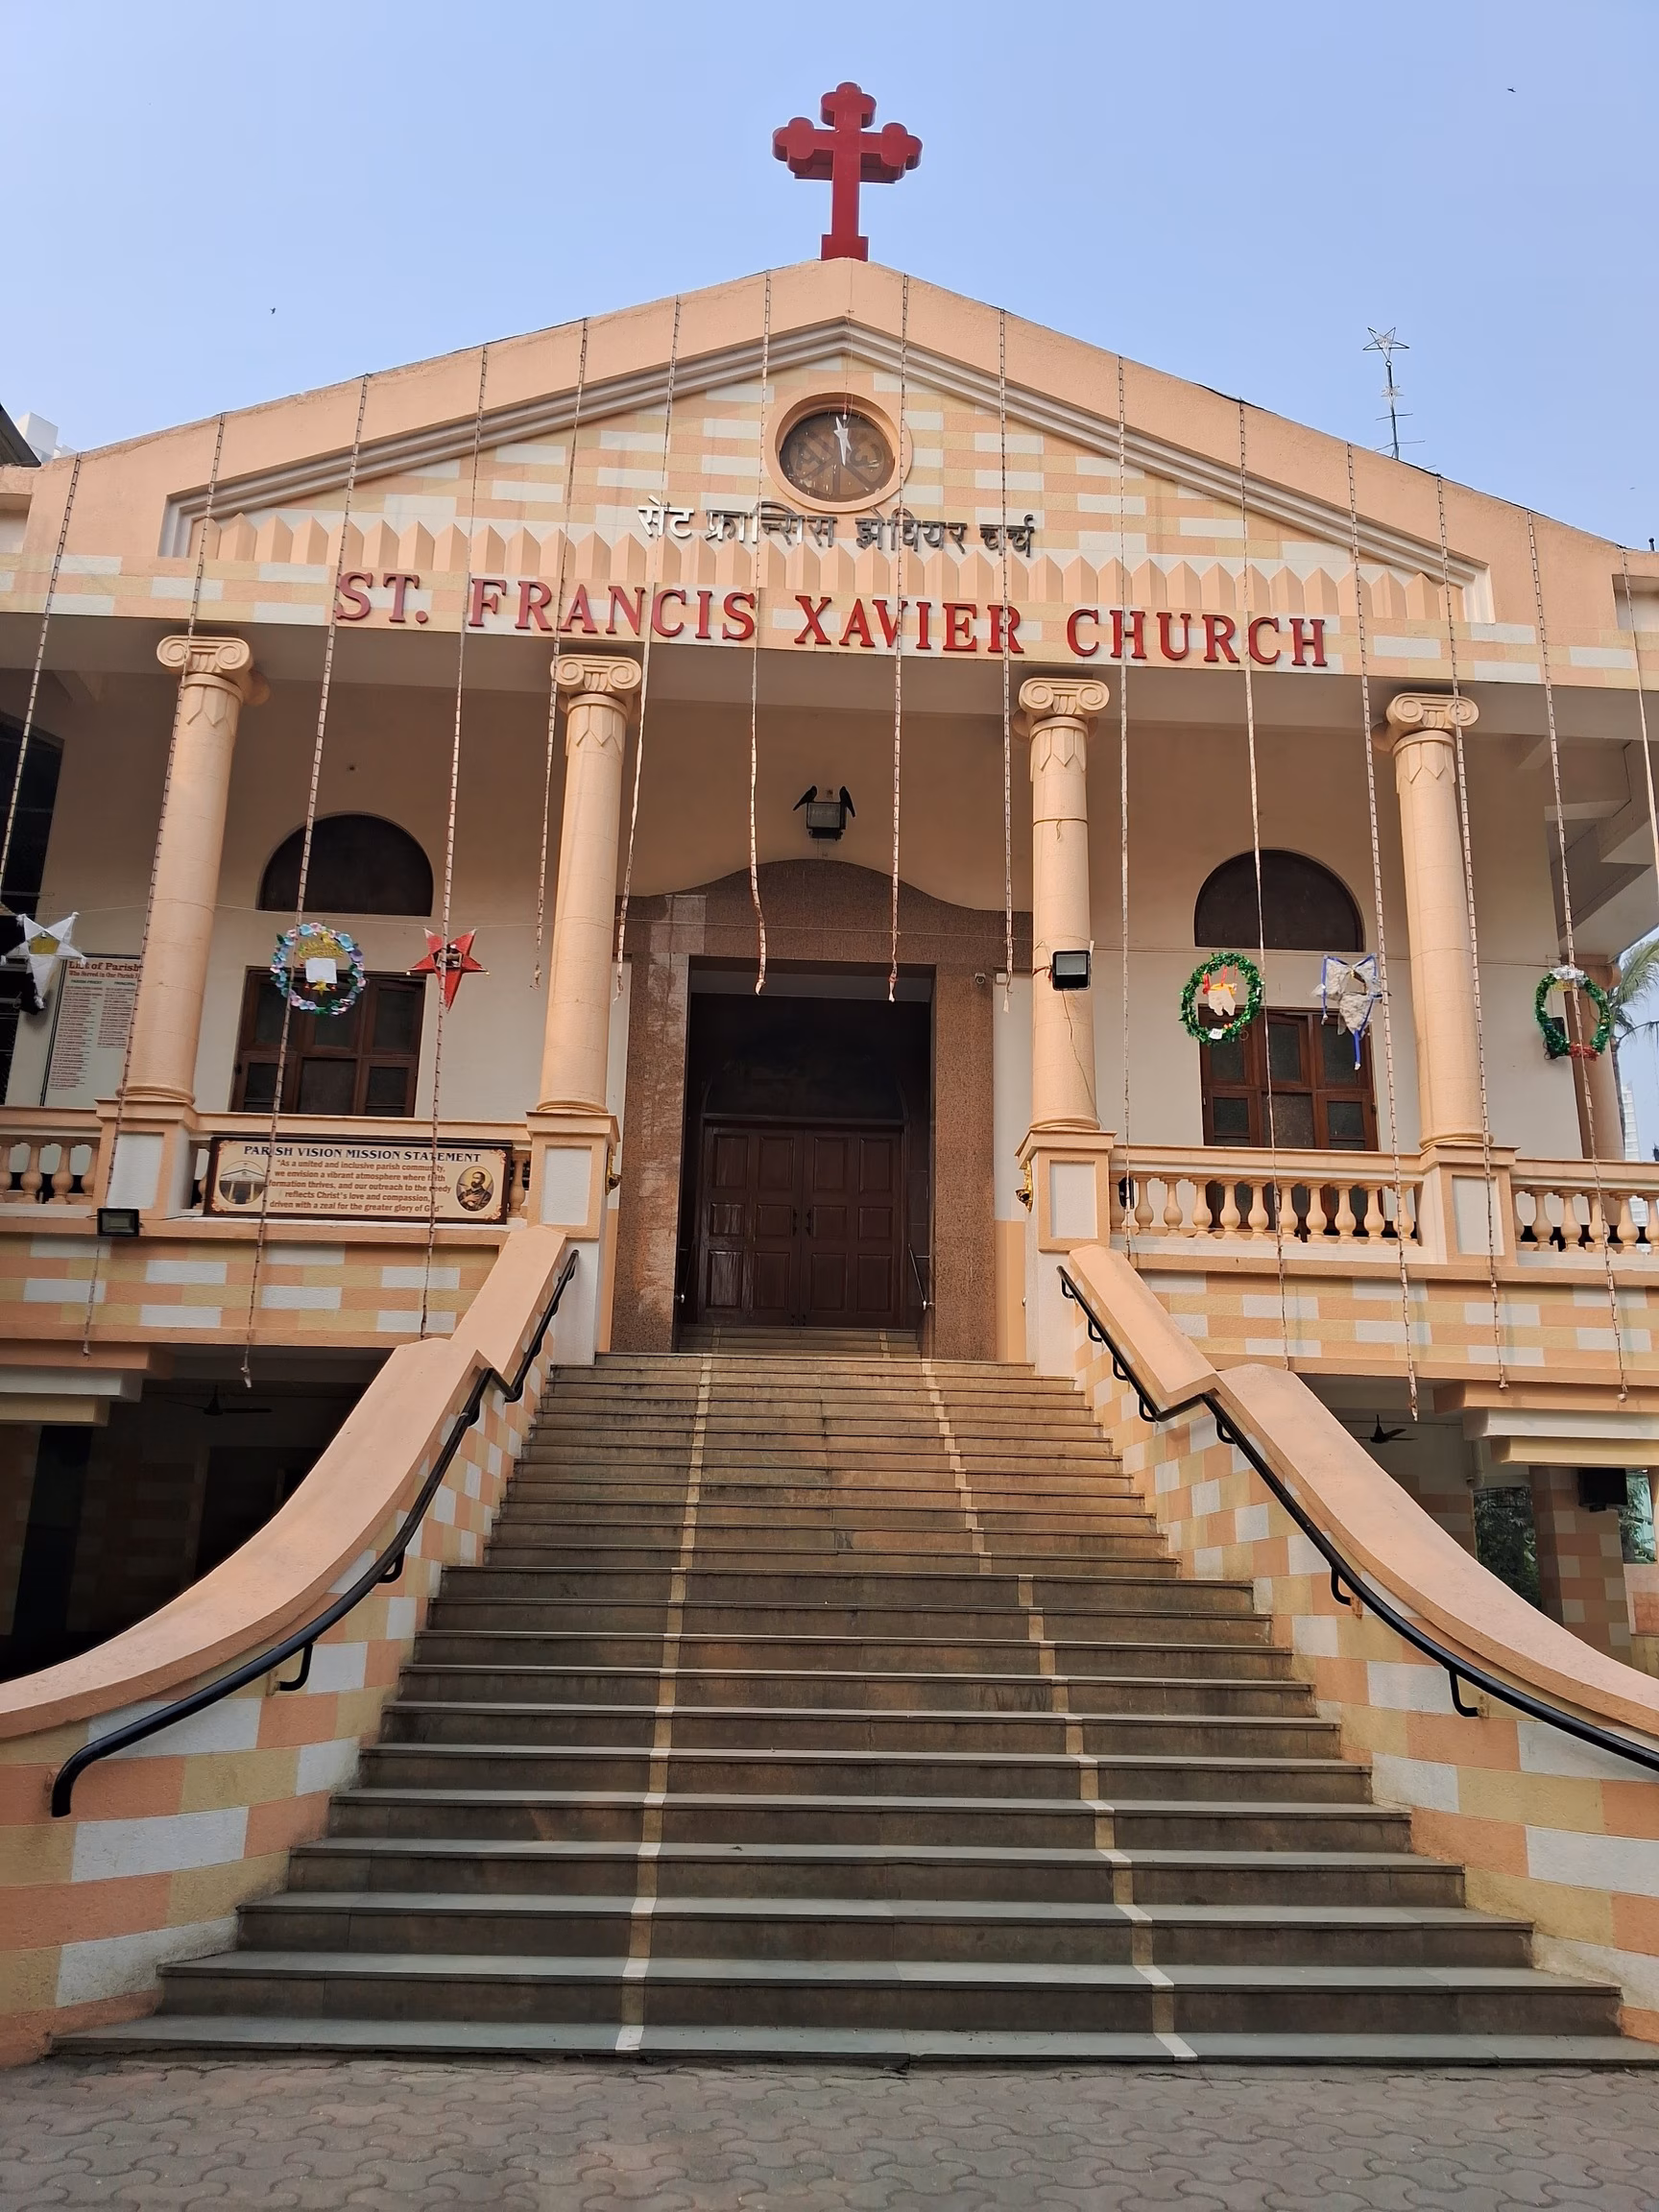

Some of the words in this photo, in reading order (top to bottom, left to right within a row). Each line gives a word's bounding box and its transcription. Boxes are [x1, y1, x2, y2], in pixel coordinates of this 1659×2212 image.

[979, 514, 1035, 558] चर्च
[336, 571, 428, 623] ST.
[468, 578, 757, 640] FRANCIS
[794, 594, 1025, 654] XAVIER
[1067, 608, 1328, 668] CHURCH
[105, 963, 139, 972] Parish
[244, 1145, 293, 1156] PARSH
[298, 1147, 343, 1158] VISION
[346, 1148, 400, 1160] MISSION
[376, 1163, 400, 1172] parish
[355, 1172, 401, 1181] atmosphere
[382, 1193, 431, 1203] compassion,
[364, 1204, 394, 1213] greater
[394, 1204, 413, 1213] glory
